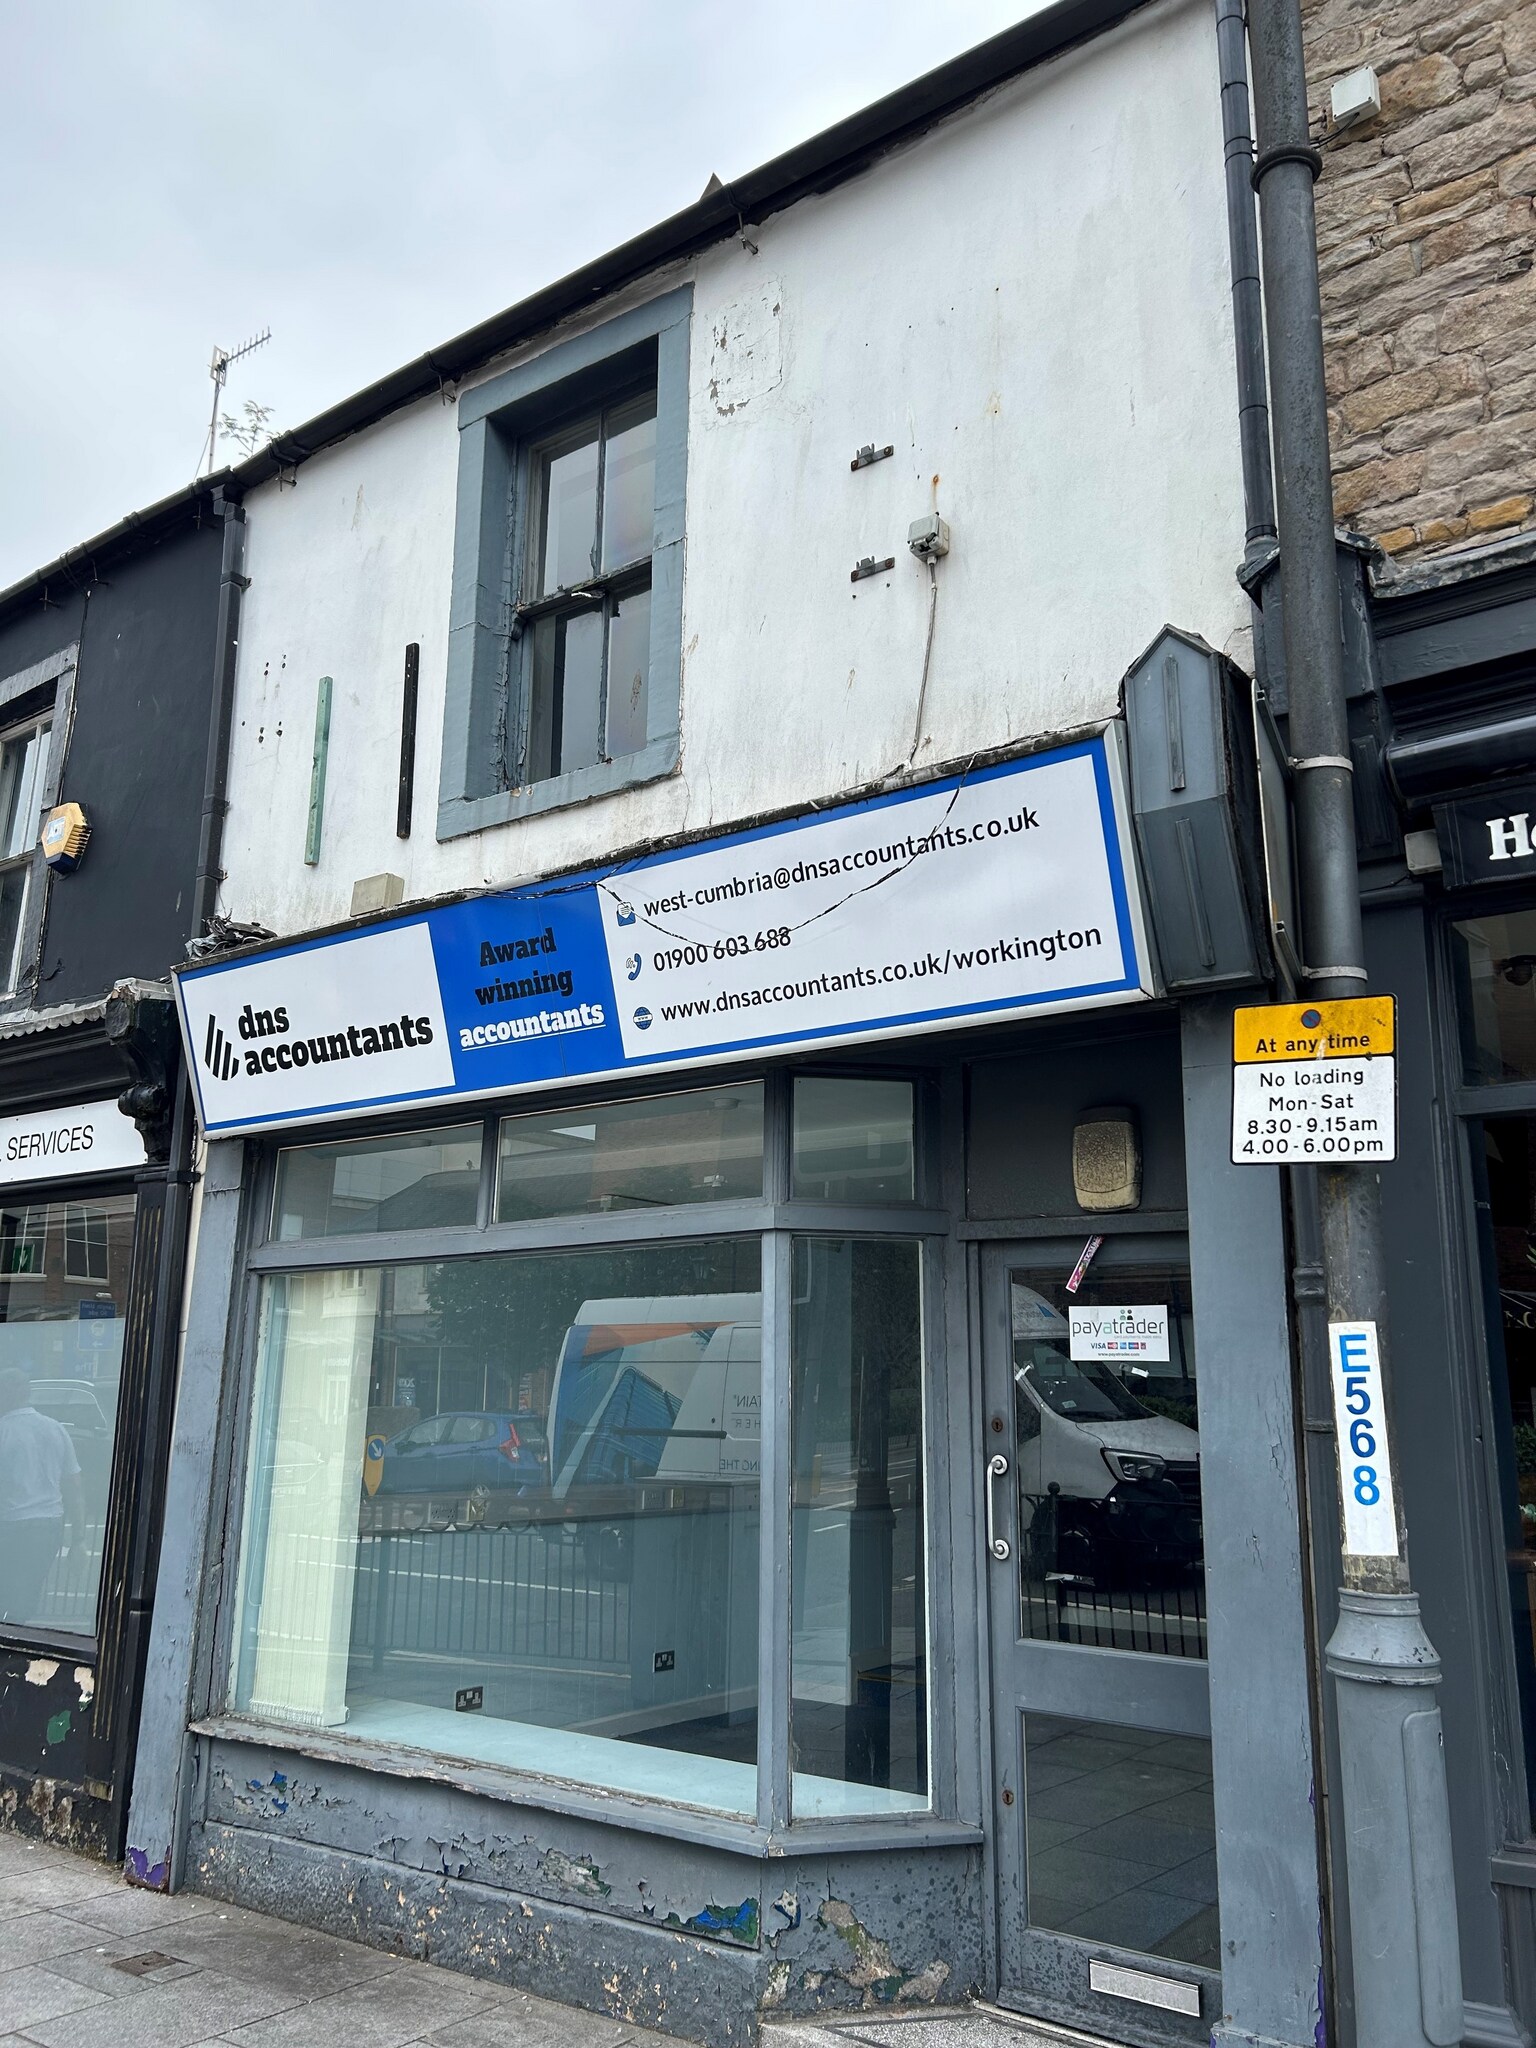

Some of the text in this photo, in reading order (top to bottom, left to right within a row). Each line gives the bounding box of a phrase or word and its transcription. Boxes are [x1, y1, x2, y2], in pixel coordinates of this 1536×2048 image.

[1485, 812, 1536, 861] H
[644, 806, 1040, 918] west-cumbria@dnsaccountants.co.uk
[479, 927, 557, 967] Award
[653, 926, 792, 973] 01900 603 688
[475, 968, 573, 1006] winning
[660, 926, 1102, 1021] www.dnsaccountants.co.uk/workington
[238, 1004, 290, 1041] dns
[459, 1002, 606, 1048] accountants
[1256, 1034, 1371, 1054] At any time
[244, 1014, 434, 1076] accountants
[1260, 1068, 1364, 1087] No loading
[6, 1124, 94, 1161] SERVICES
[1072, 1318, 1164, 1337] payatrader
[1338, 1334, 1381, 1506] E568
